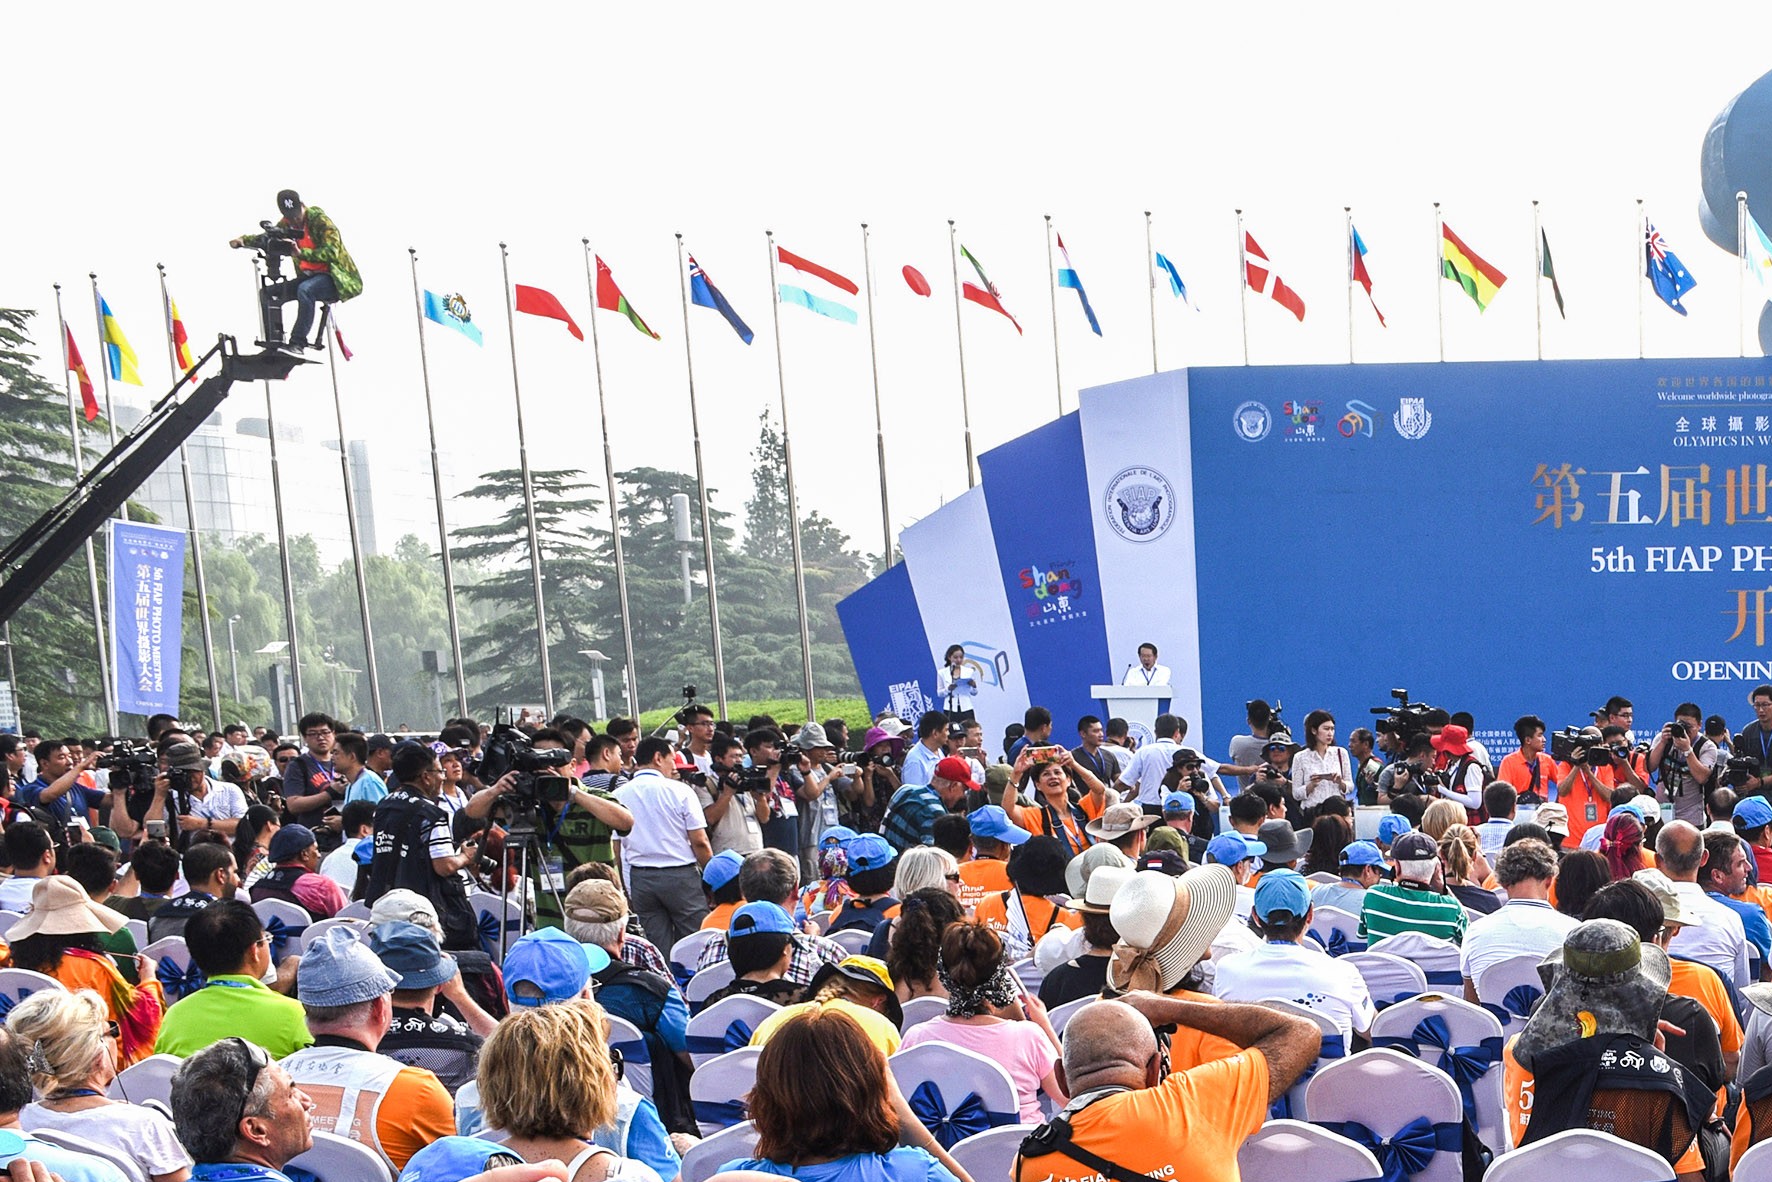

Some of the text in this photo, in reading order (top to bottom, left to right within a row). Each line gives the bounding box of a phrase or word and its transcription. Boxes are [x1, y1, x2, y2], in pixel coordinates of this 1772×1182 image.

[1657, 391, 1696, 400] Welcome
[1697, 391, 1737, 400] worldwide
[1673, 435, 1738, 447] OLYMPICS
[1740, 435, 1755, 446] IN
[1591, 545, 1636, 573] 5th
[1645, 545, 1723, 572] FIAP
[152, 580, 164, 607] FIAP
[134, 563, 152, 692] 第五届世界摄影大会
[152, 607, 163, 645] PHOTO
[152, 645, 164, 693] MEETING
[889, 680, 919, 694] EIPAA
